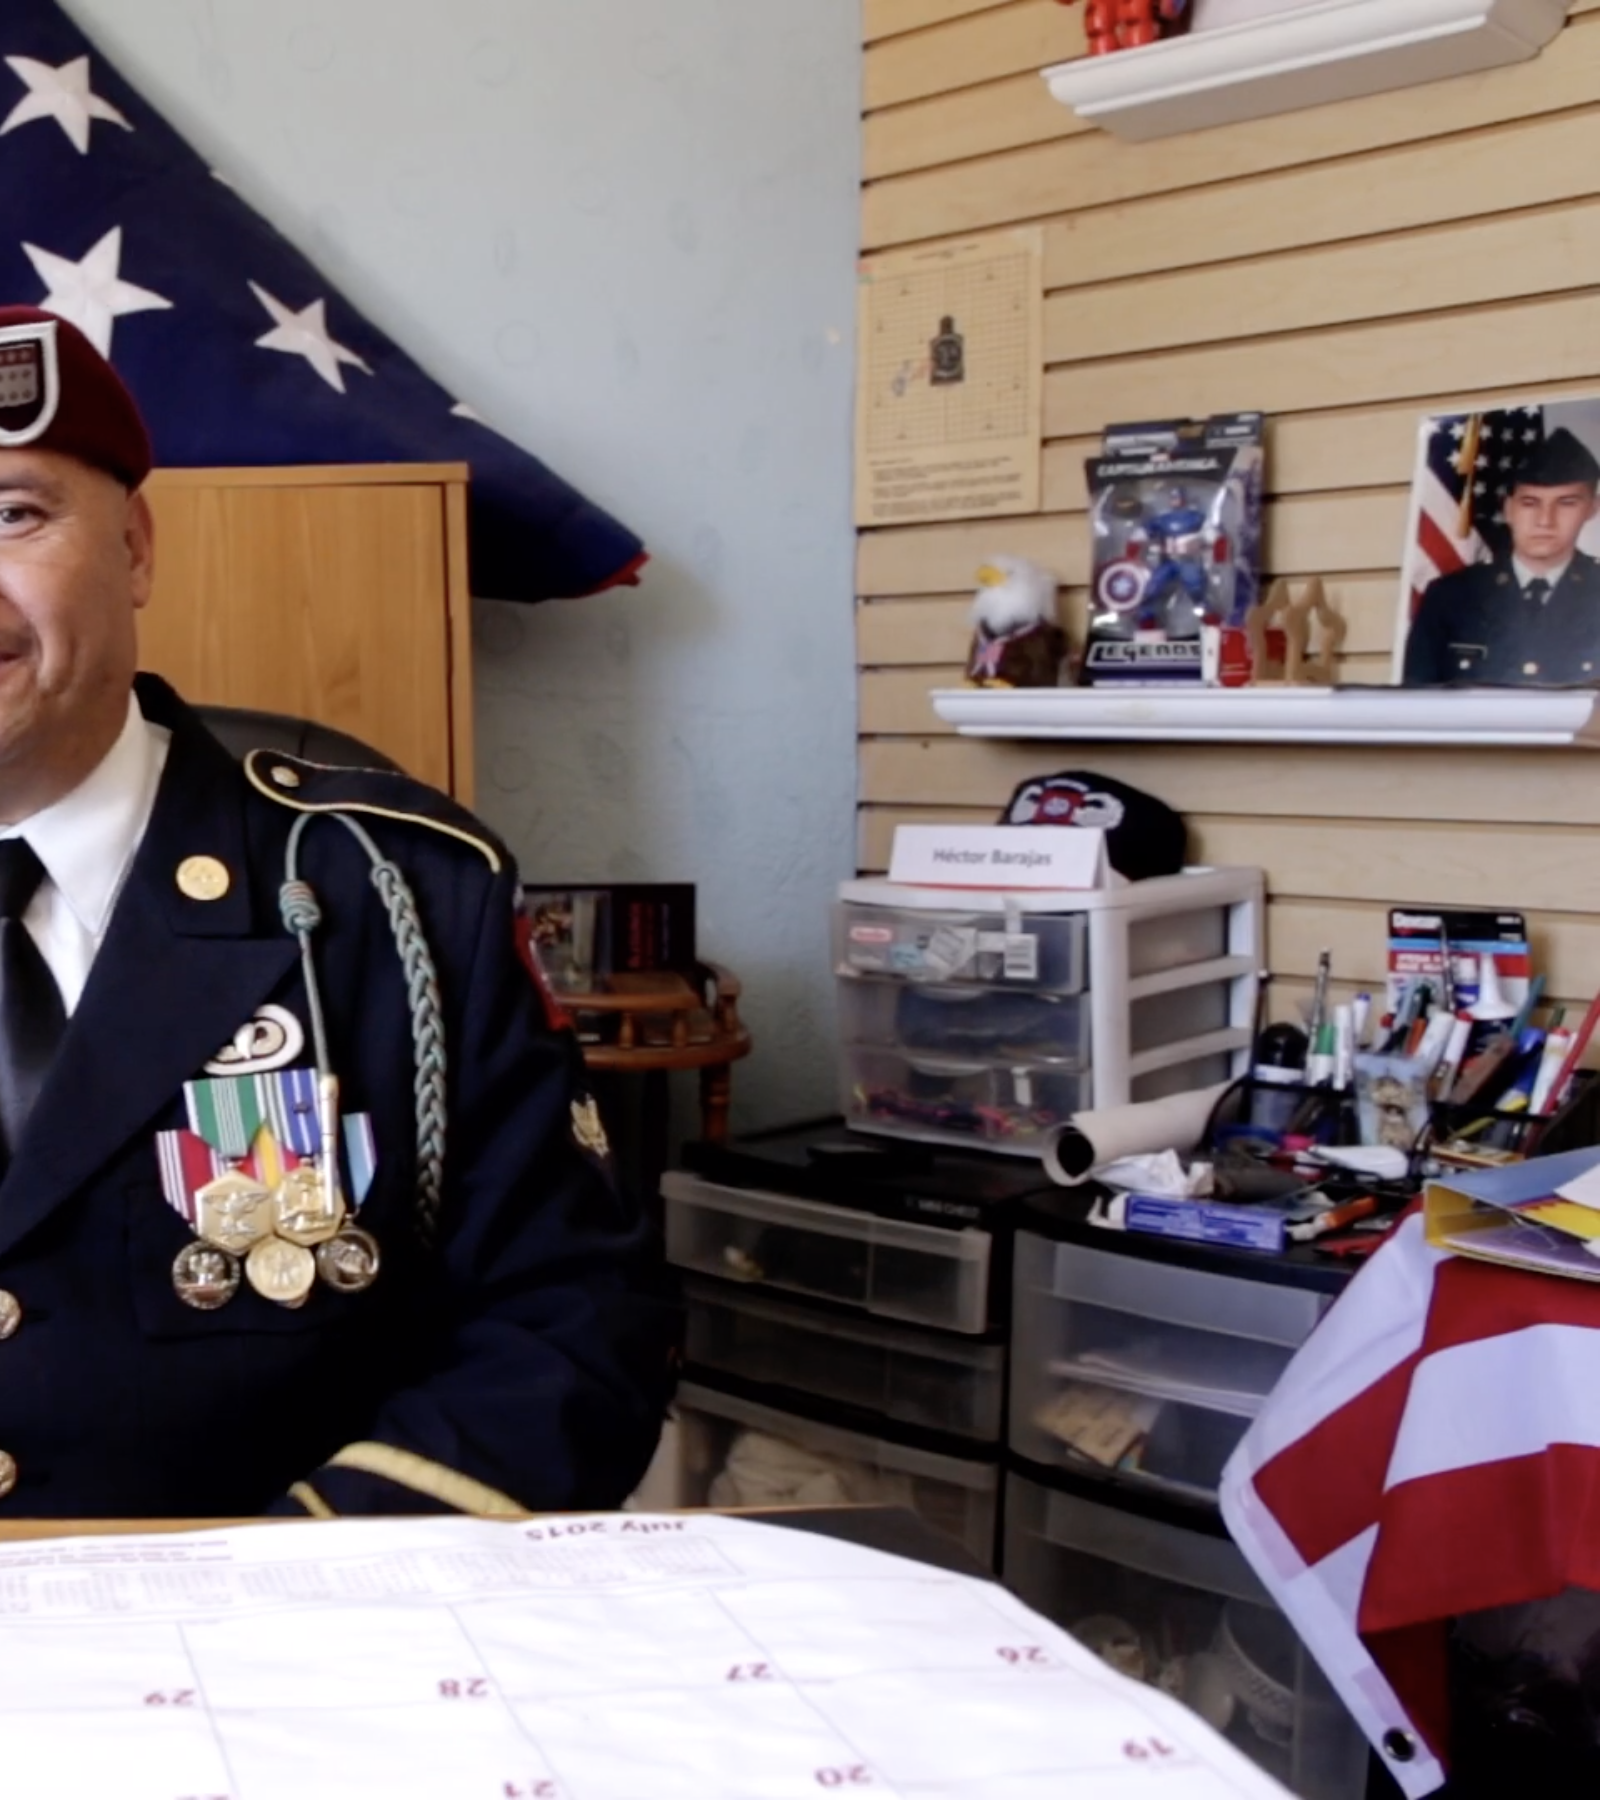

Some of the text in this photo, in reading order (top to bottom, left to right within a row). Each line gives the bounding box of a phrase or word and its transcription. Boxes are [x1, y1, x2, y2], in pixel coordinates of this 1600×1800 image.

[933, 847, 1052, 867] Héctor Barajas
[525, 1520, 687, 1541] July 2015
[996, 1645, 1048, 1665] 26
[726, 1662, 773, 1682] 27
[144, 1689, 195, 1706] 29
[439, 1678, 488, 1698] 28
[1121, 1736, 1174, 1761] 19
[814, 1764, 874, 1788] 20
